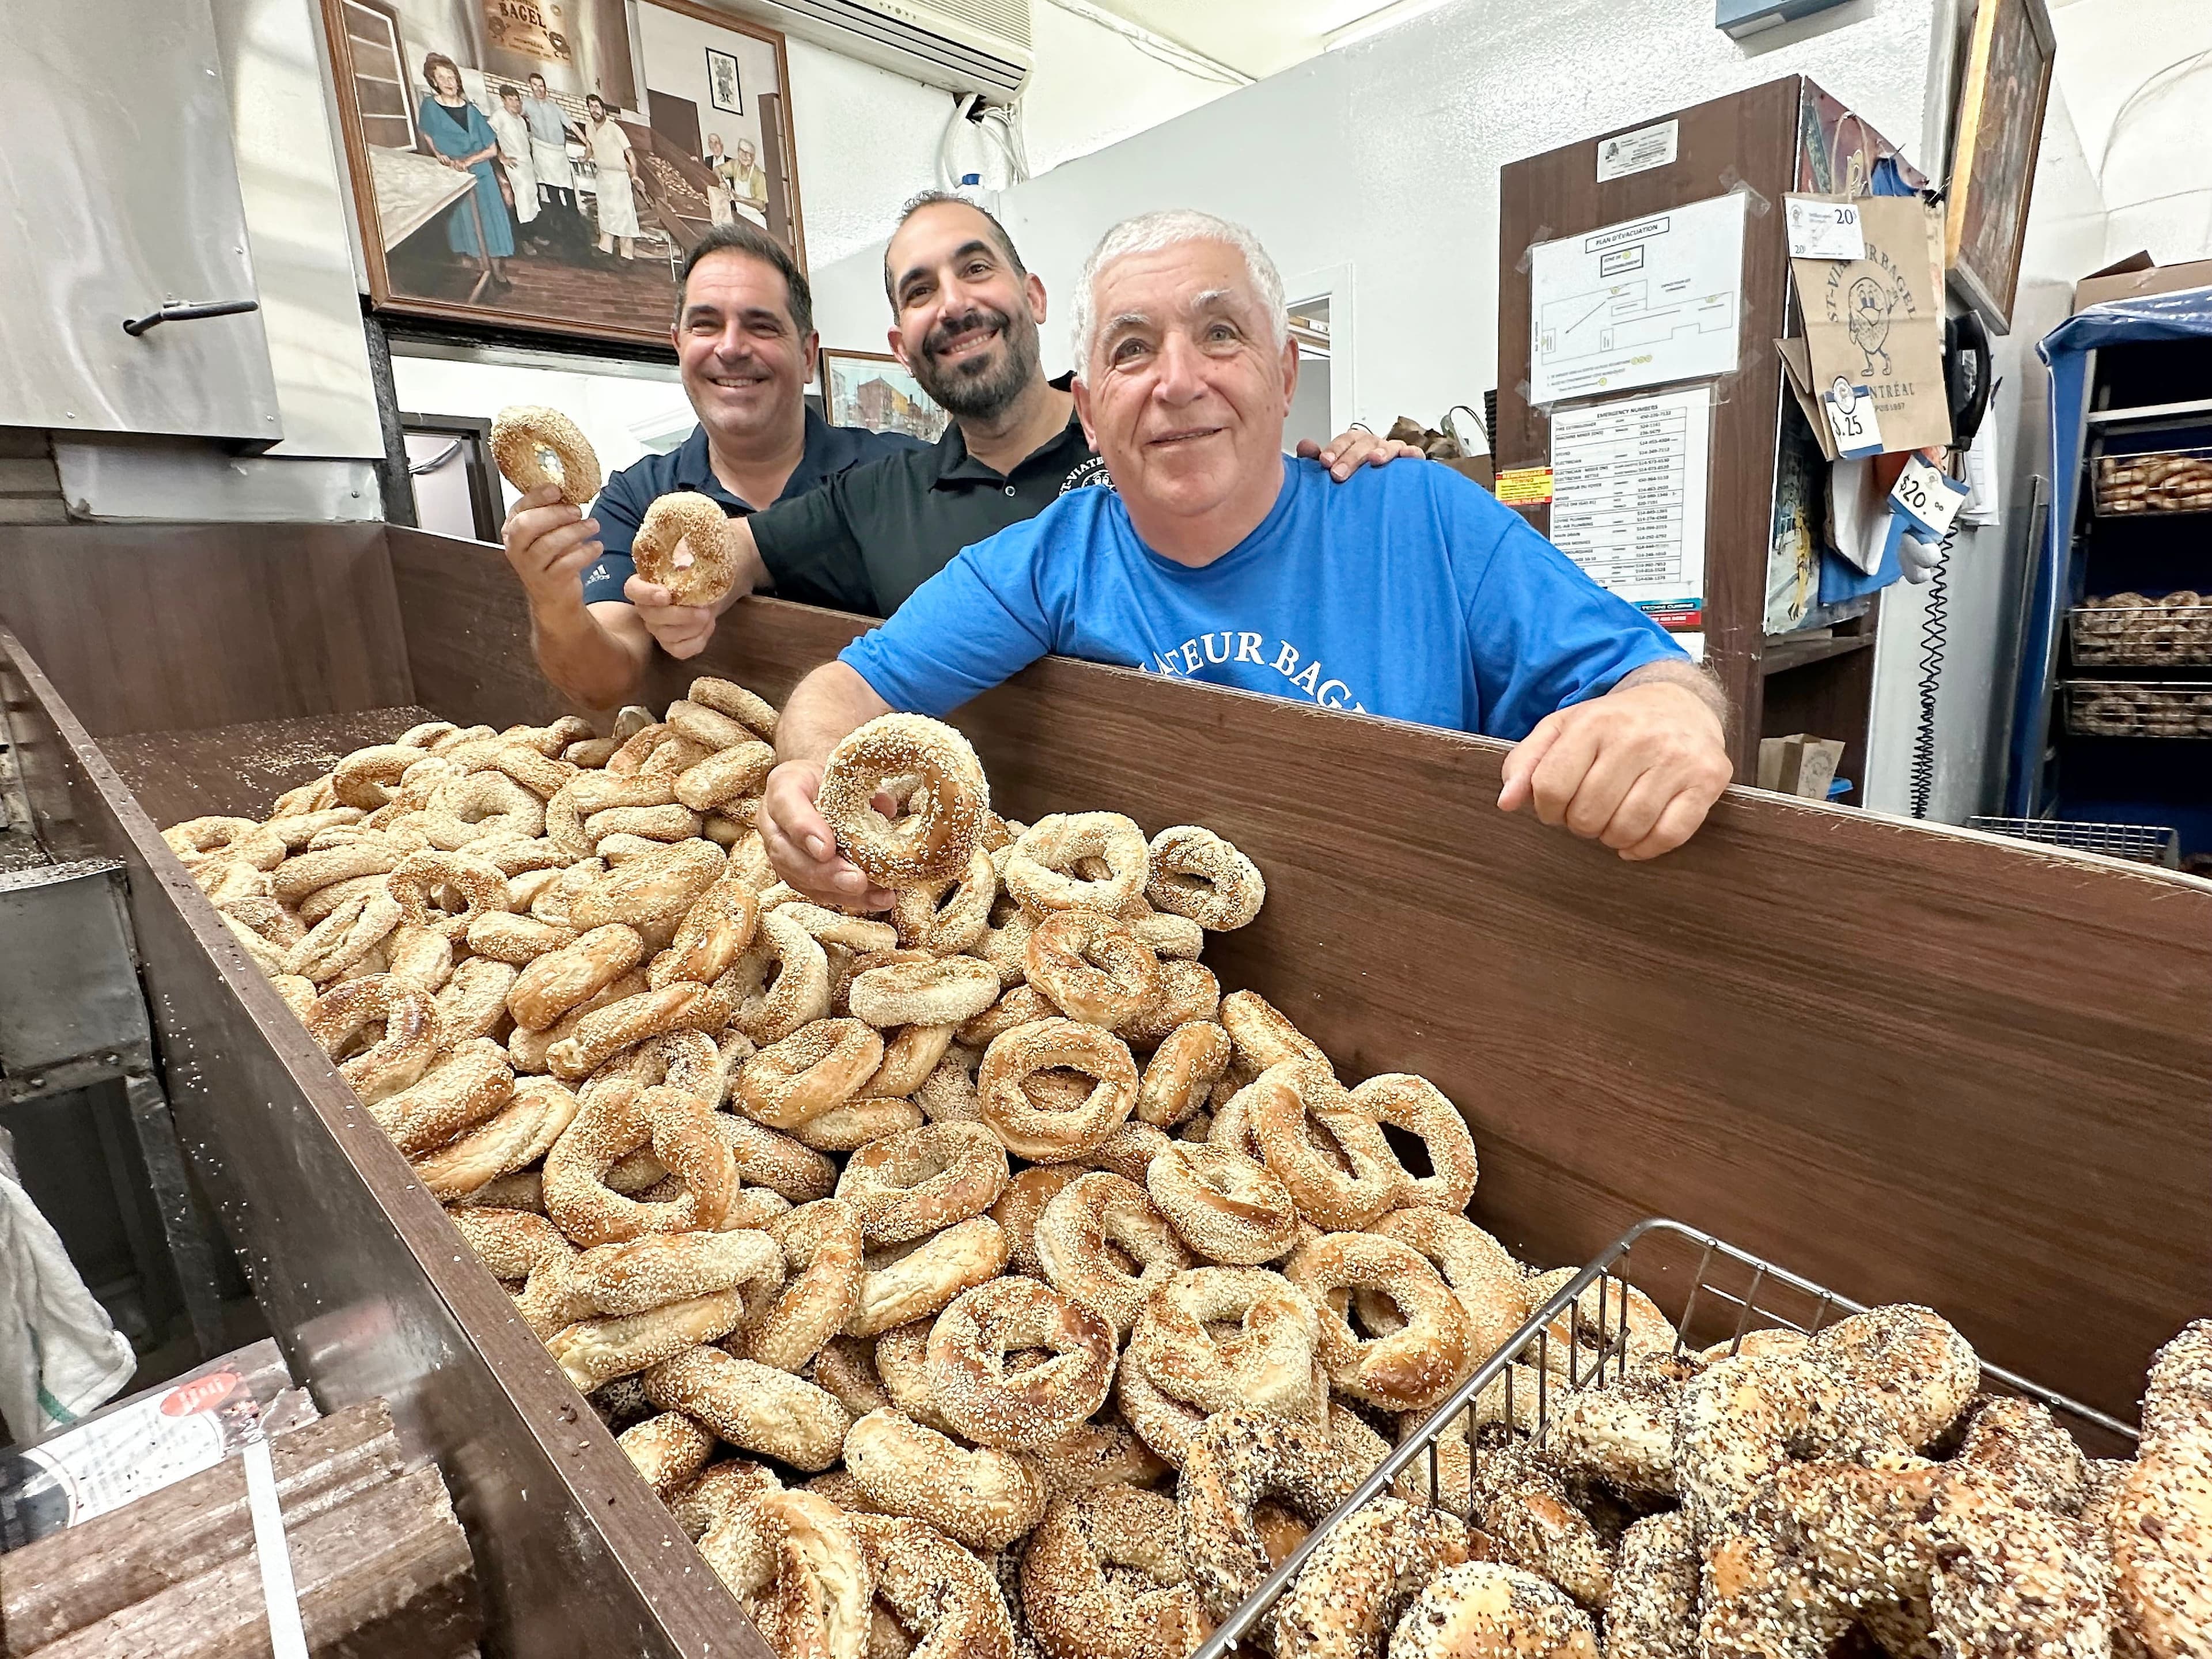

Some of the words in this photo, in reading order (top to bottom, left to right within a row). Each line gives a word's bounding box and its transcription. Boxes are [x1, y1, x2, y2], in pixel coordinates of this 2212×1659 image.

[498, 2, 547, 29] BAGEL
[1596, 237, 1611, 245] PLAN
[1612, 224, 1658, 241] D'ÉVACUATION
[1881, 252, 1916, 320] BAGEL
[1869, 381, 1915, 399] NTRÉAL
[1597, 410, 1629, 418] EMERGENCY
[1631, 405, 1658, 414] NUMBERS
[1832, 411, 1863, 442] $.25
[1059, 456, 1104, 496] T-VIATE
[1139, 631, 1266, 676] ATEUR
[1268, 639, 1368, 714] BAG
